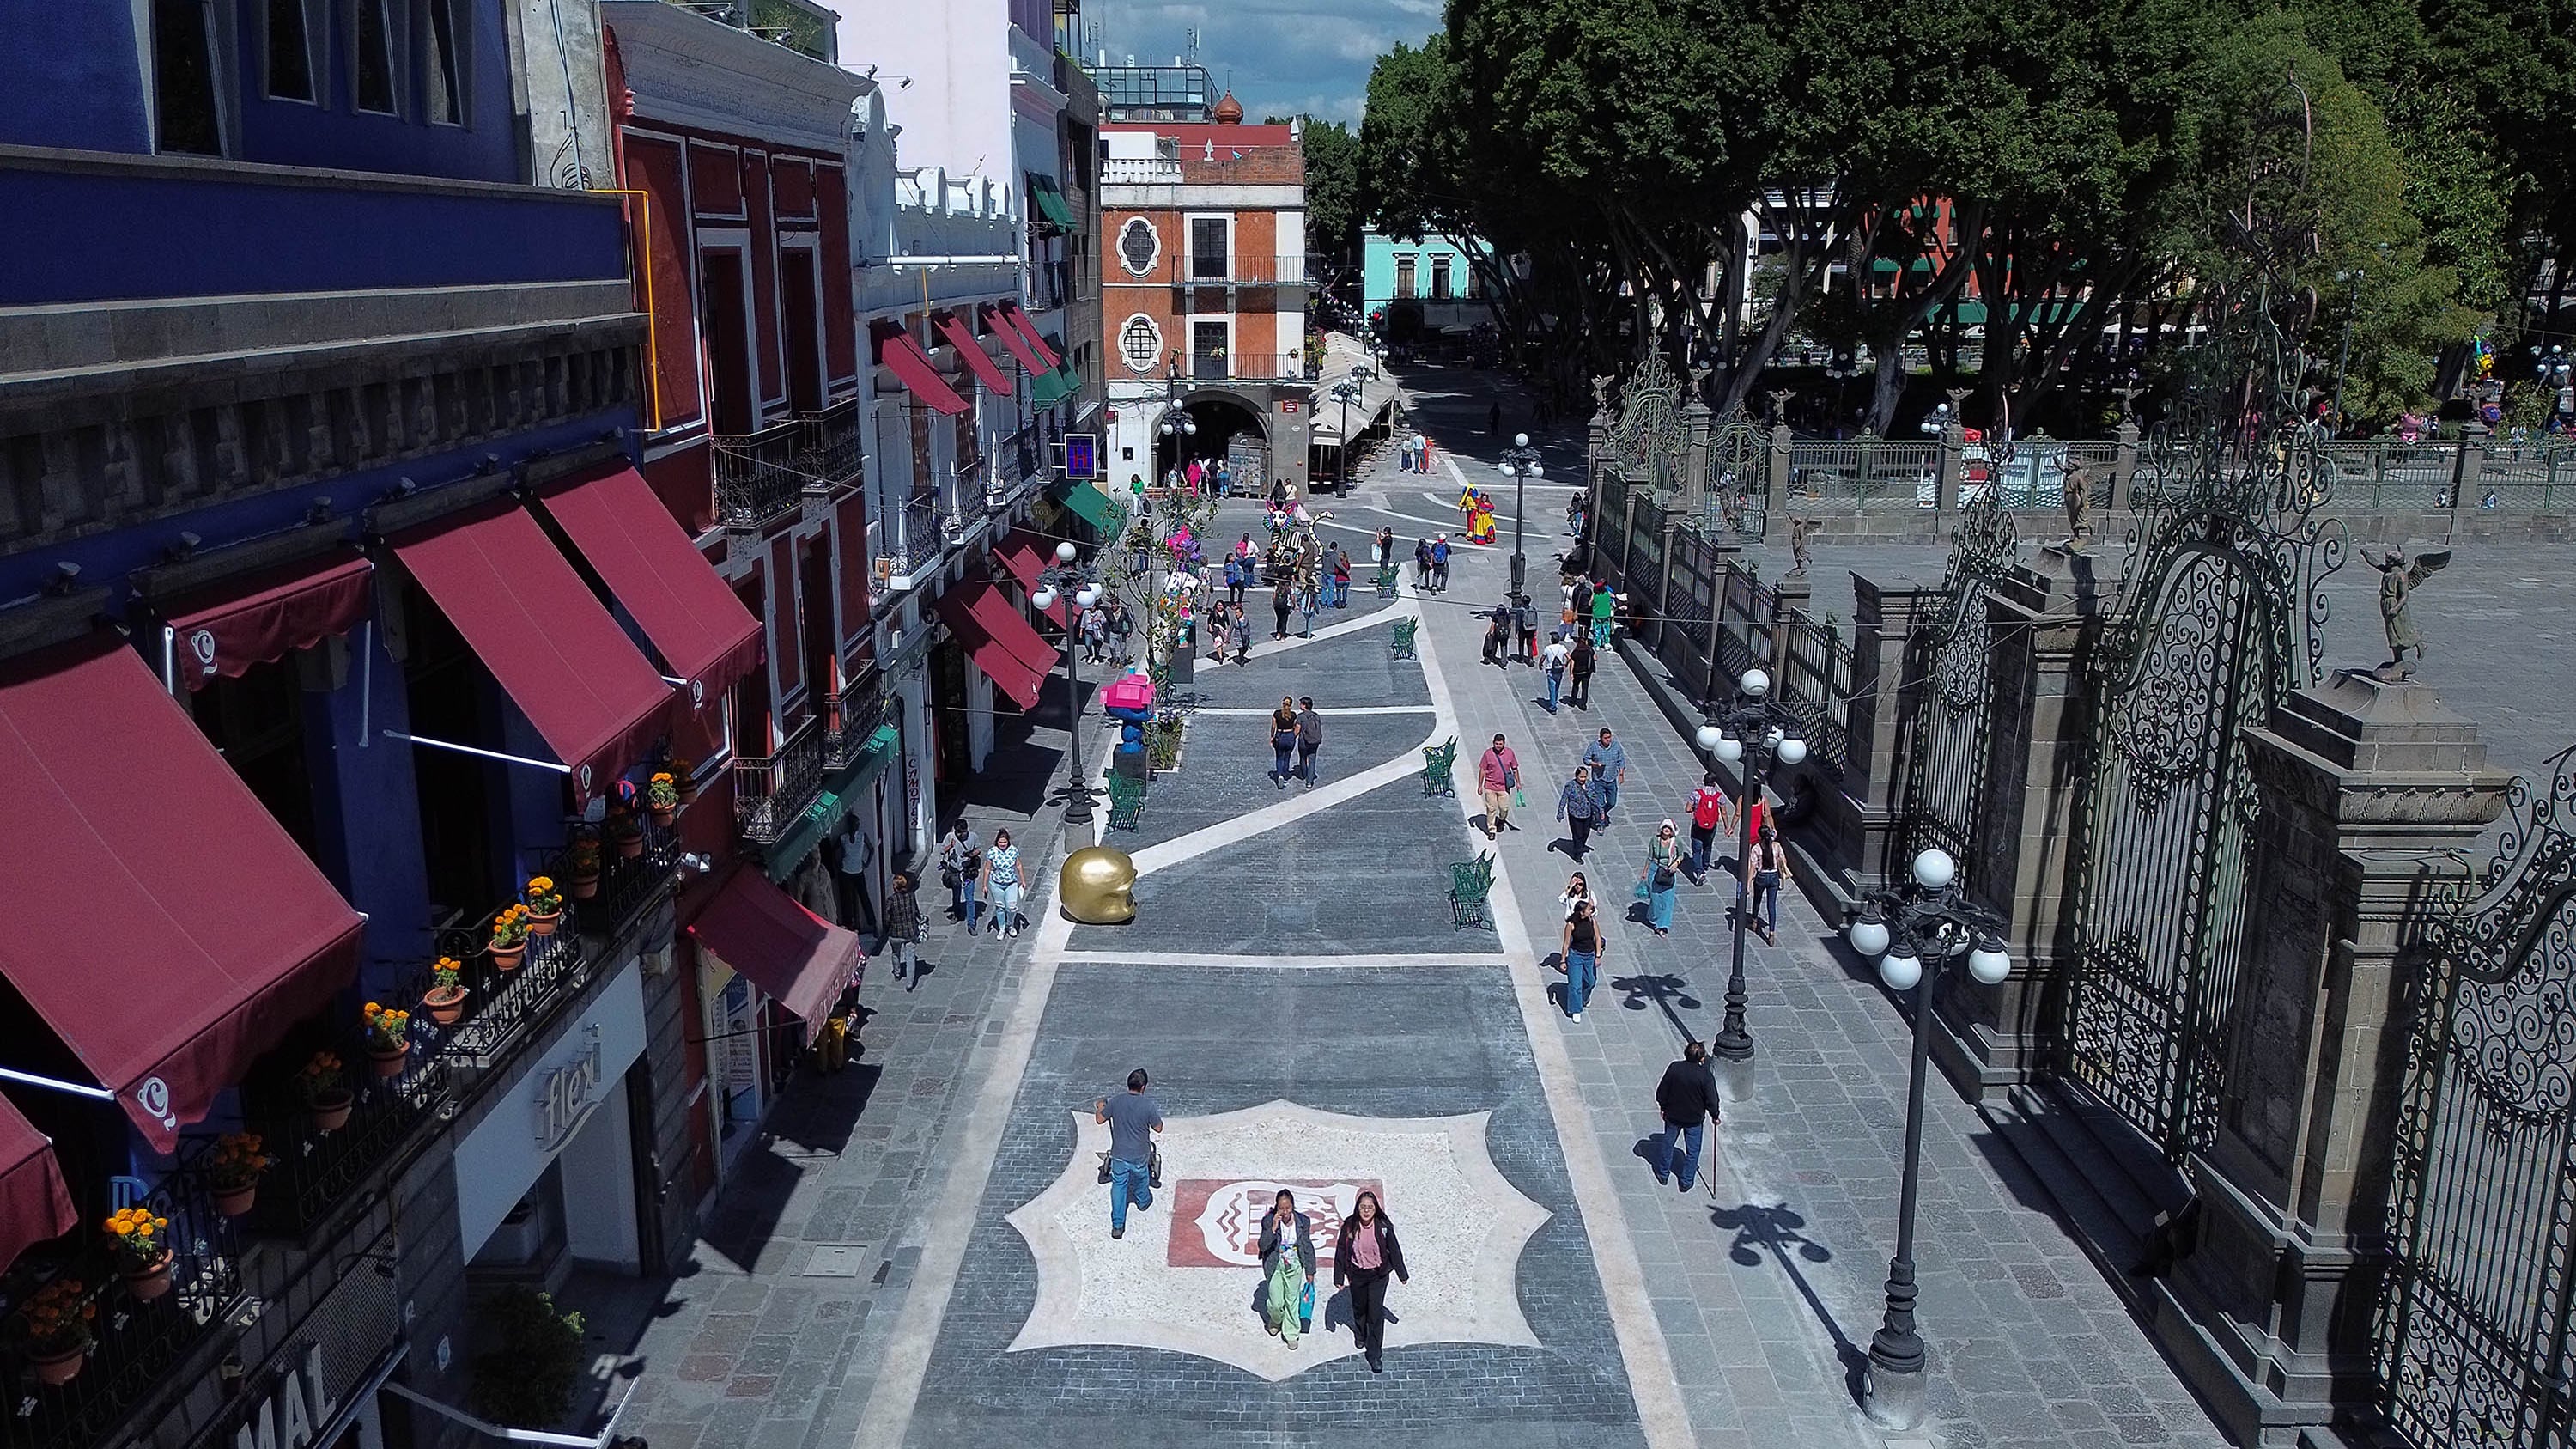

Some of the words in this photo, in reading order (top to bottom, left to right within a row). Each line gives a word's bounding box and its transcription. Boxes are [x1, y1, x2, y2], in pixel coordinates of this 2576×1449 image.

[1074, 445, 1087, 469] H
[908, 758, 920, 826] CAMOTES
[545, 1023, 603, 1141] flexi
